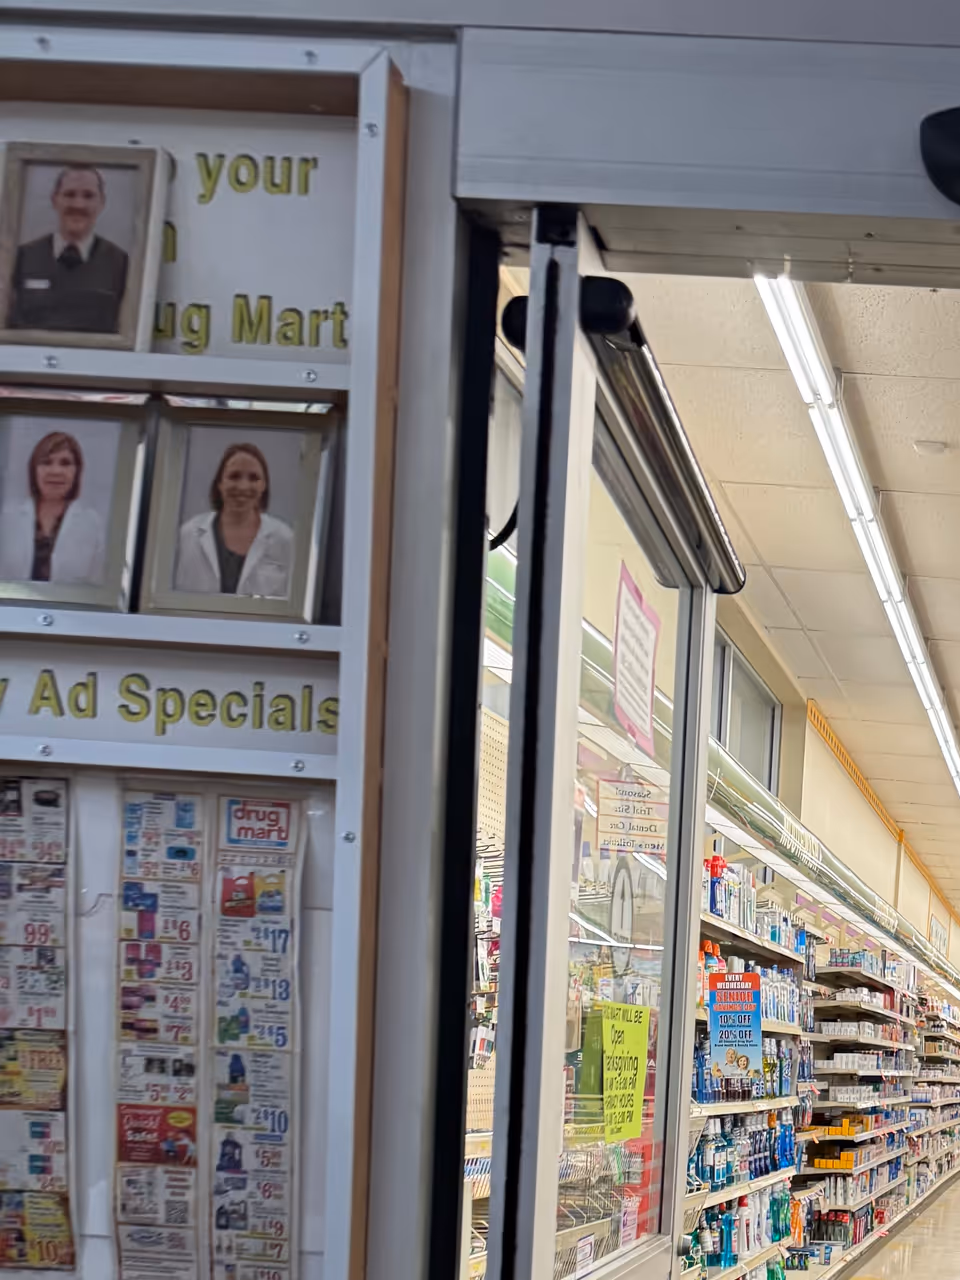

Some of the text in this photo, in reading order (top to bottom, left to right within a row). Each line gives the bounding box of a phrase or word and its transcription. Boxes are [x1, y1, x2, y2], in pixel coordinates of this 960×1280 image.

[196, 152, 319, 205] your
[154, 293, 349, 355] ug Mart
[28, 668, 98, 719] Ad
[117, 672, 339, 737] Specials
[233, 806, 281, 828] drug
[237, 824, 288, 842] mart
[725, 973, 743, 982] EVERY
[716, 981, 752, 989] WEDNESDAY
[715, 991, 754, 1003] SENIOR
[712, 1003, 743, 1012] SAVINGS
[621, 1008, 633, 1022] WILL
[633, 1010, 644, 1024] BE
[718, 1014, 752, 1024] 10% OFF
[610, 1023, 625, 1050] Open
[718, 1029, 752, 1040] 20% OFF
[628, 1076, 638, 1090] PM
[626, 1110, 634, 1123] PM
